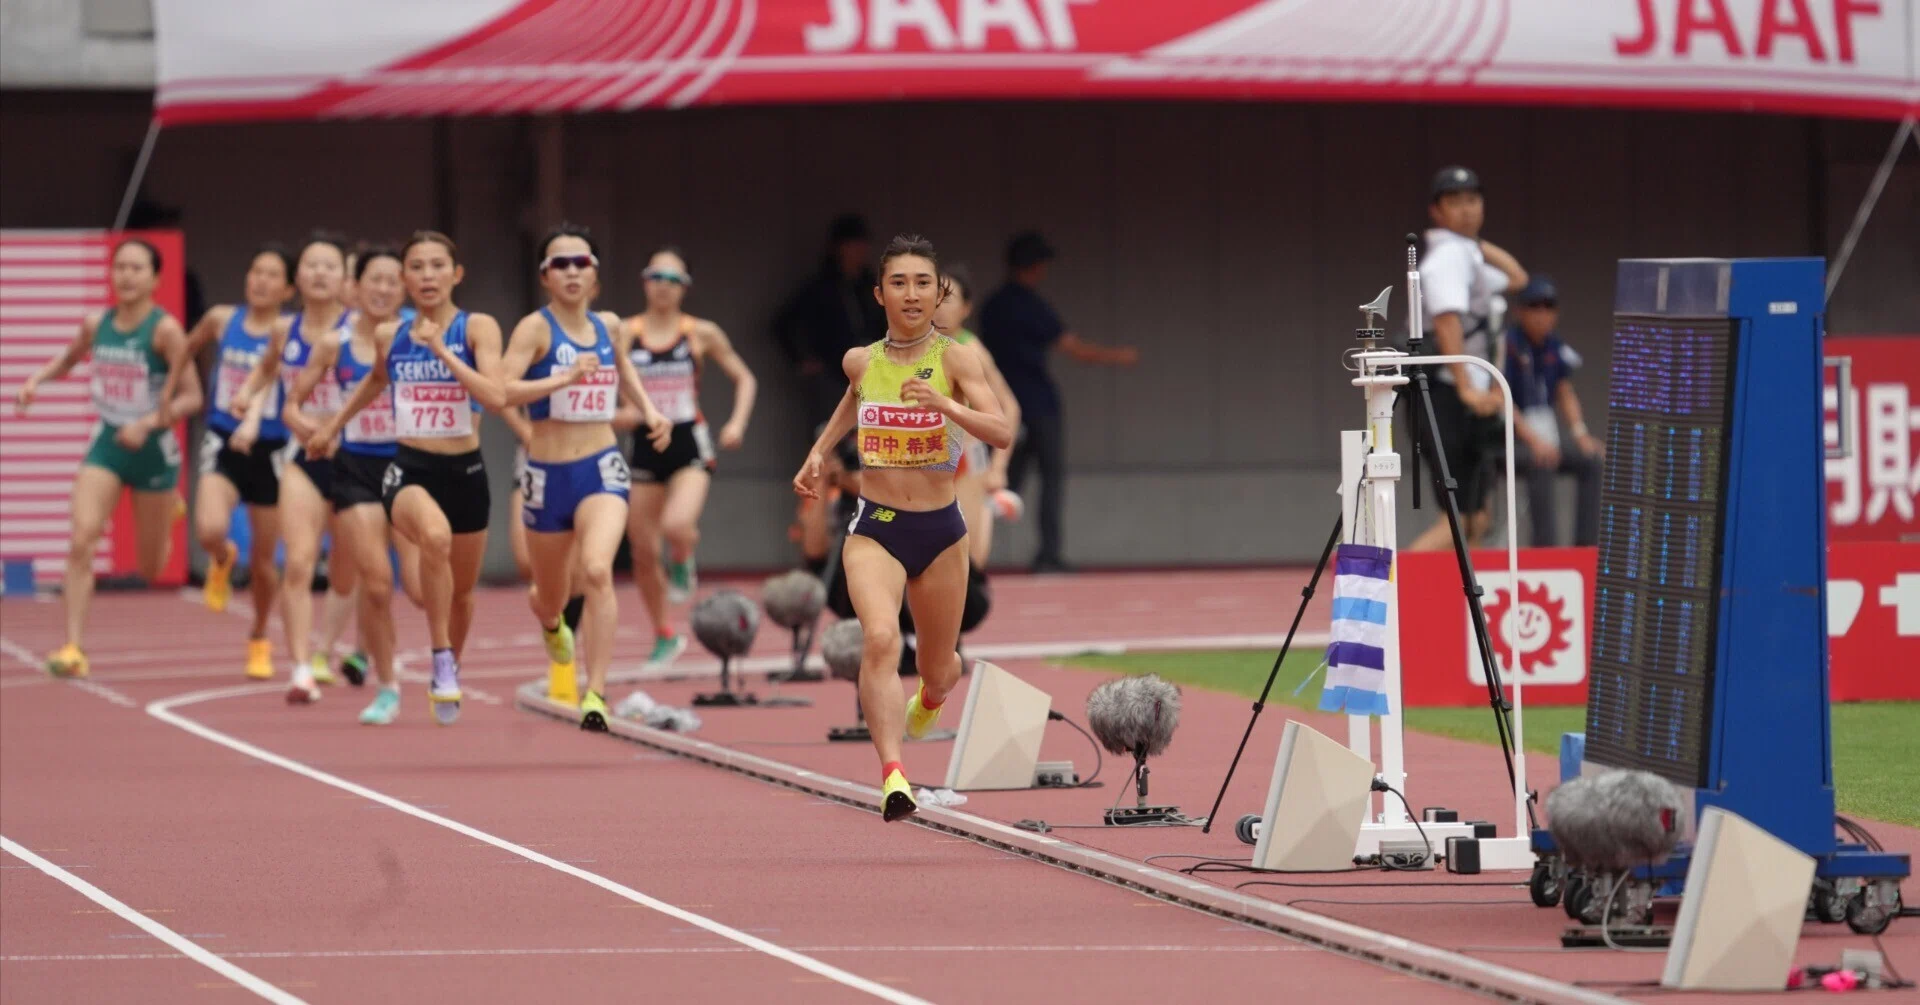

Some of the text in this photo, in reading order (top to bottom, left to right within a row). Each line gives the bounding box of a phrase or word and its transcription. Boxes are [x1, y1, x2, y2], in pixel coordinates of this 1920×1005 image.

[1614, 0, 1881, 63] JAAF
[568, 390, 605, 412] 746
[412, 406, 455, 428] 773
[882, 411, 939, 424] ヤマザキ
[864, 434, 943, 455] 田中 希実
